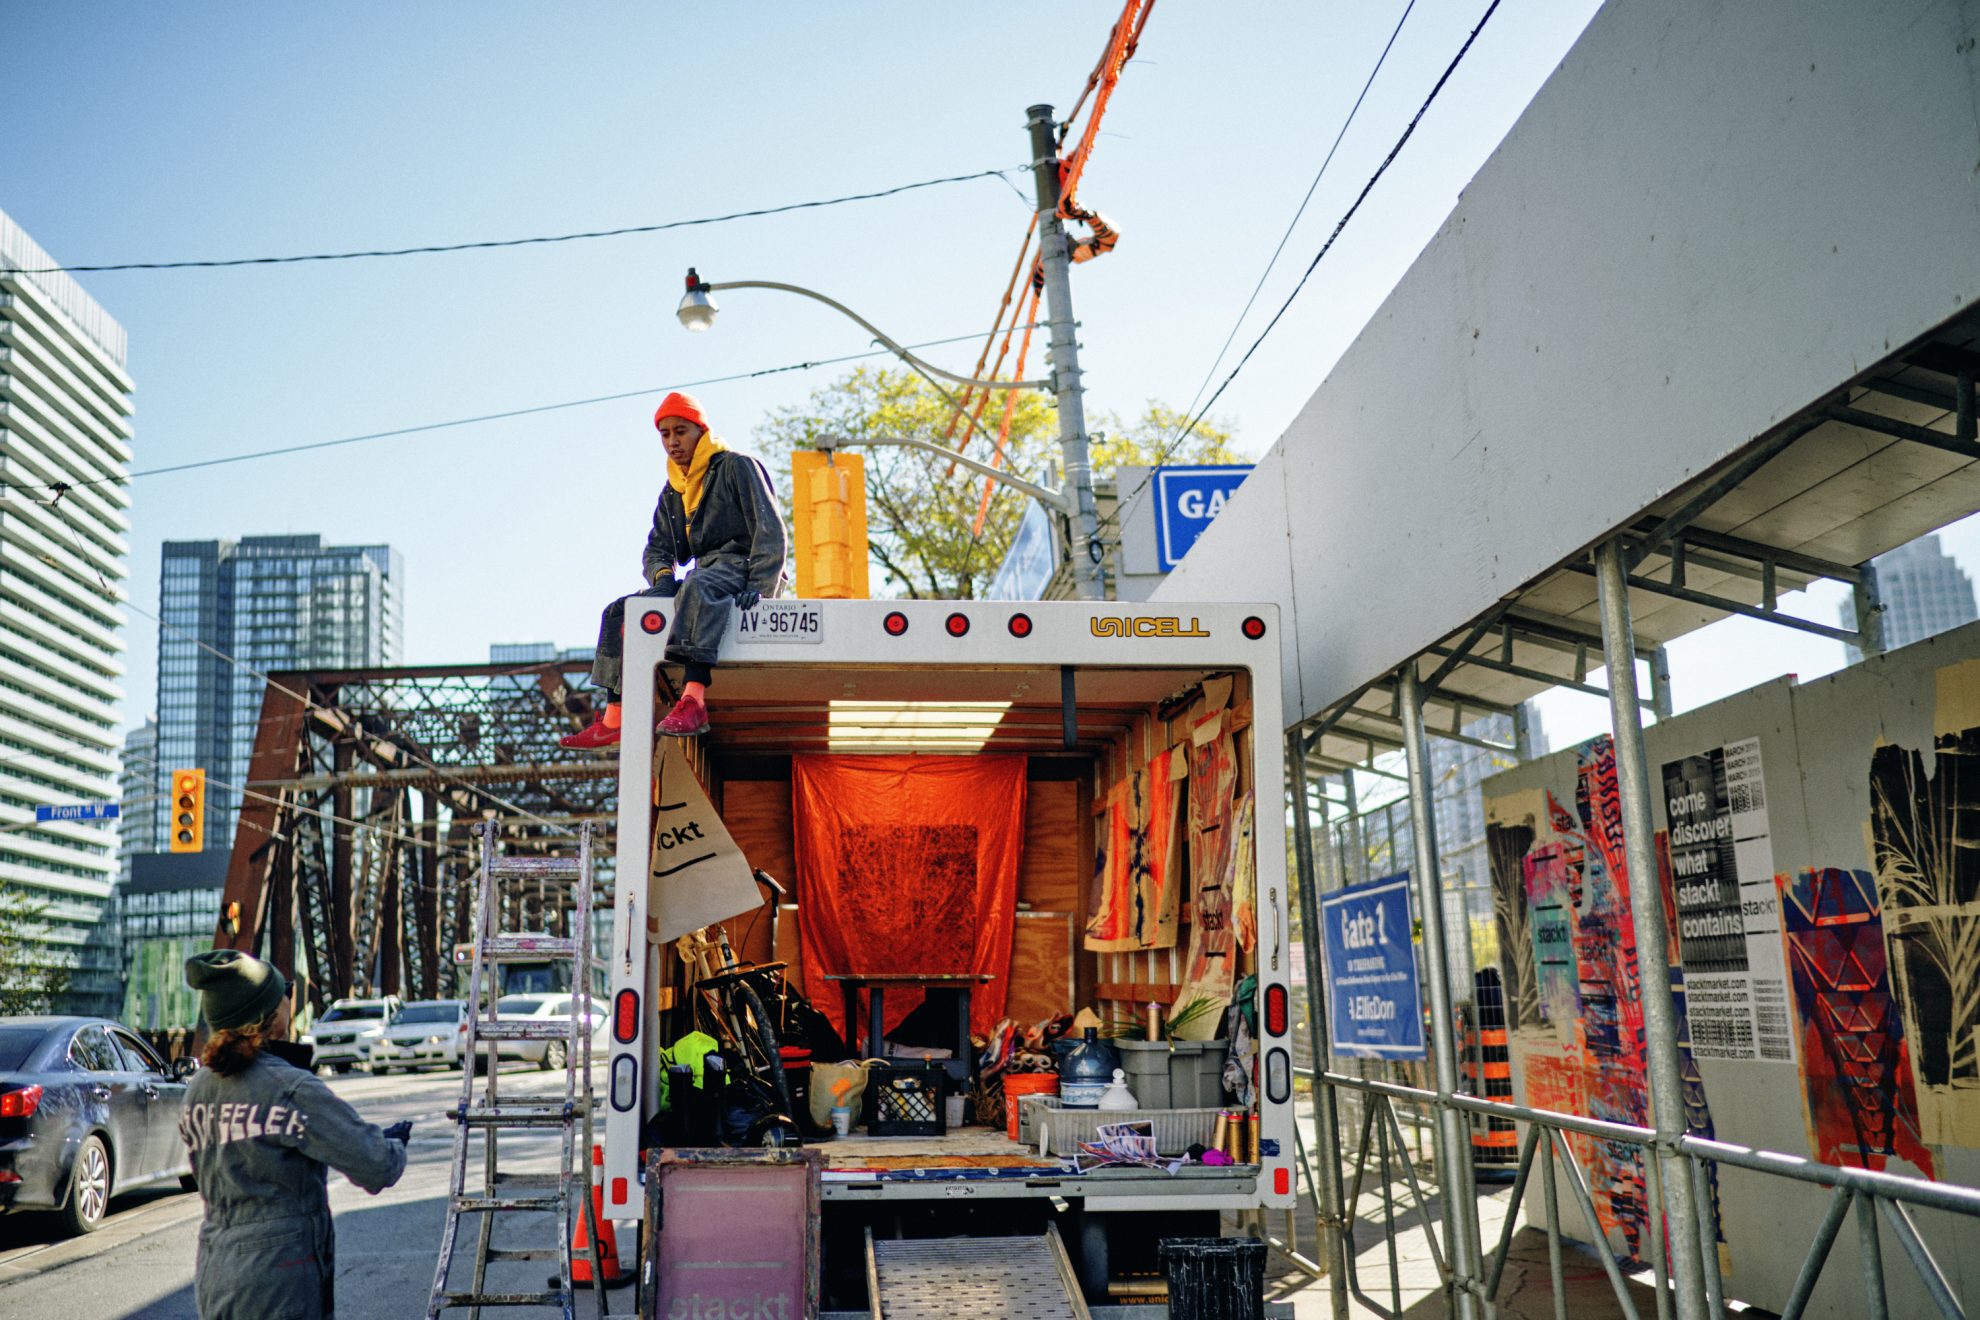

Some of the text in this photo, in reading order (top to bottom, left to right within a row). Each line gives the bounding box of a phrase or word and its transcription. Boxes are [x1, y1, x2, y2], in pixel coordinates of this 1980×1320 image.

[1177, 488, 1238, 519] GA
[770, 612, 819, 632] 96745
[1090, 616, 1210, 637] UNICELL
[51, 805, 81, 818] Front
[95, 804, 104, 817] W
[1670, 791, 1706, 816] come
[656, 820, 705, 850] ckt
[1672, 816, 1731, 846] discover
[1675, 849, 1709, 876] what
[1679, 878, 1721, 906] stackt
[1743, 898, 1777, 916] stackt
[1376, 901, 1389, 945] 1
[1683, 911, 1742, 938] contains
[1538, 926, 1567, 944] stackt
[1687, 979, 1747, 990] stacktmarket.com
[1688, 992, 1749, 1003] stacktmarket.com
[1689, 1005, 1751, 1017] stacktmarket.com
[1694, 1047, 1756, 1059] stacktmarket.com
[667, 1291, 789, 1320] stackt
